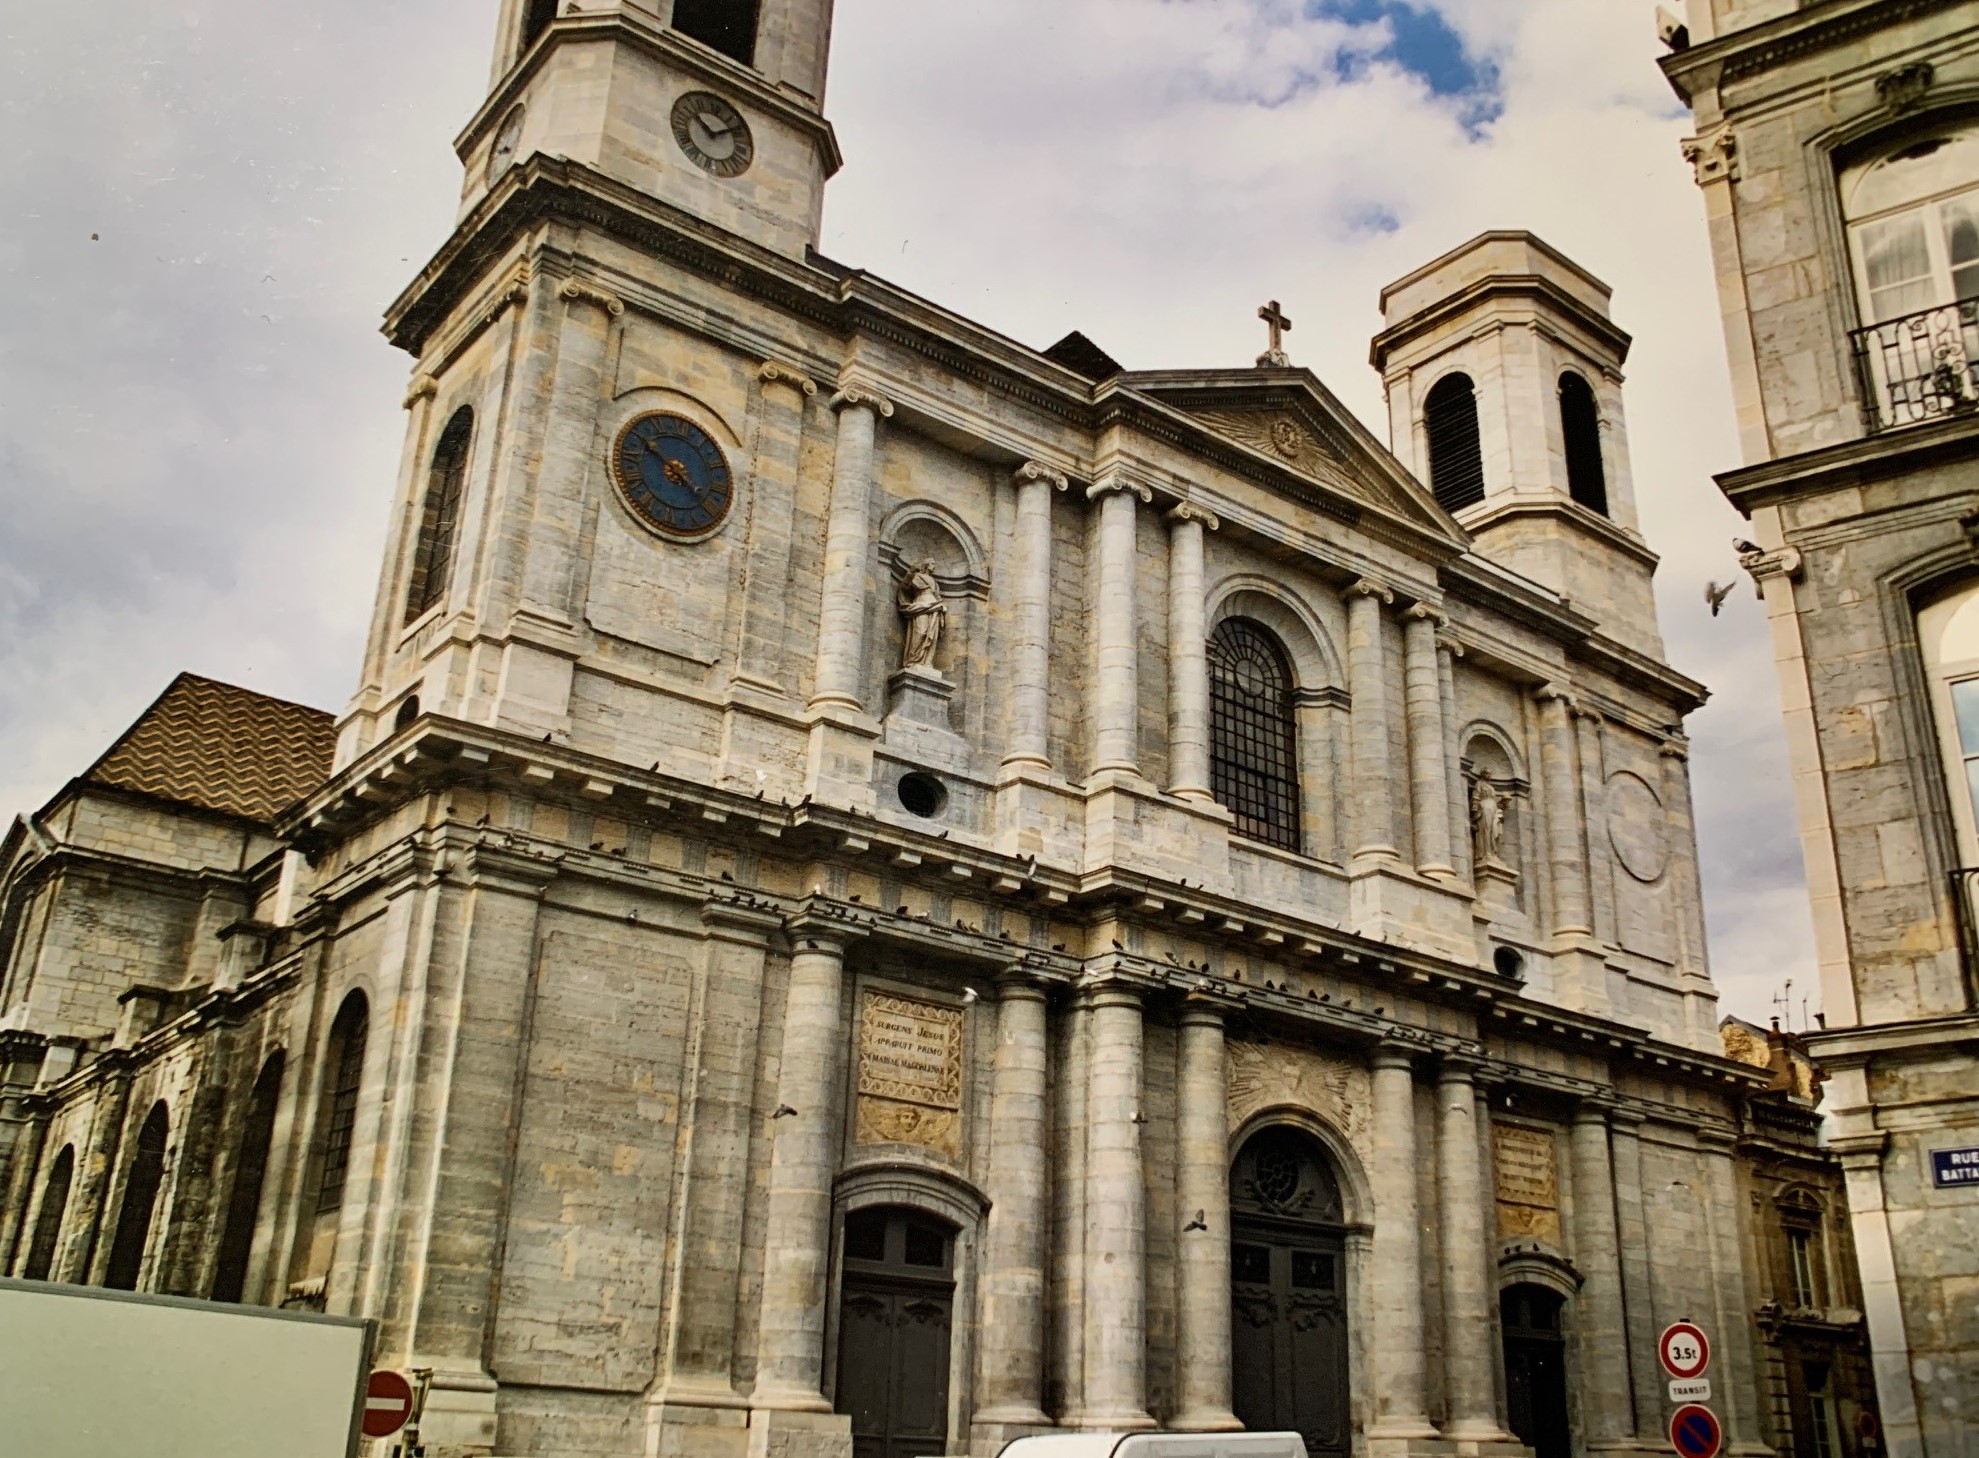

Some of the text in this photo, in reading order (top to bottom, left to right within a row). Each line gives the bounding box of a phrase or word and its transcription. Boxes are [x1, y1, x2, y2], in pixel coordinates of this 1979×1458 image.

[877, 1021, 944, 1041] SURGENS JESUS
[917, 1045, 943, 1057] PRIMO
[1951, 1152, 1979, 1164] RUE
[1673, 1386, 1707, 1395] TRANSIT
